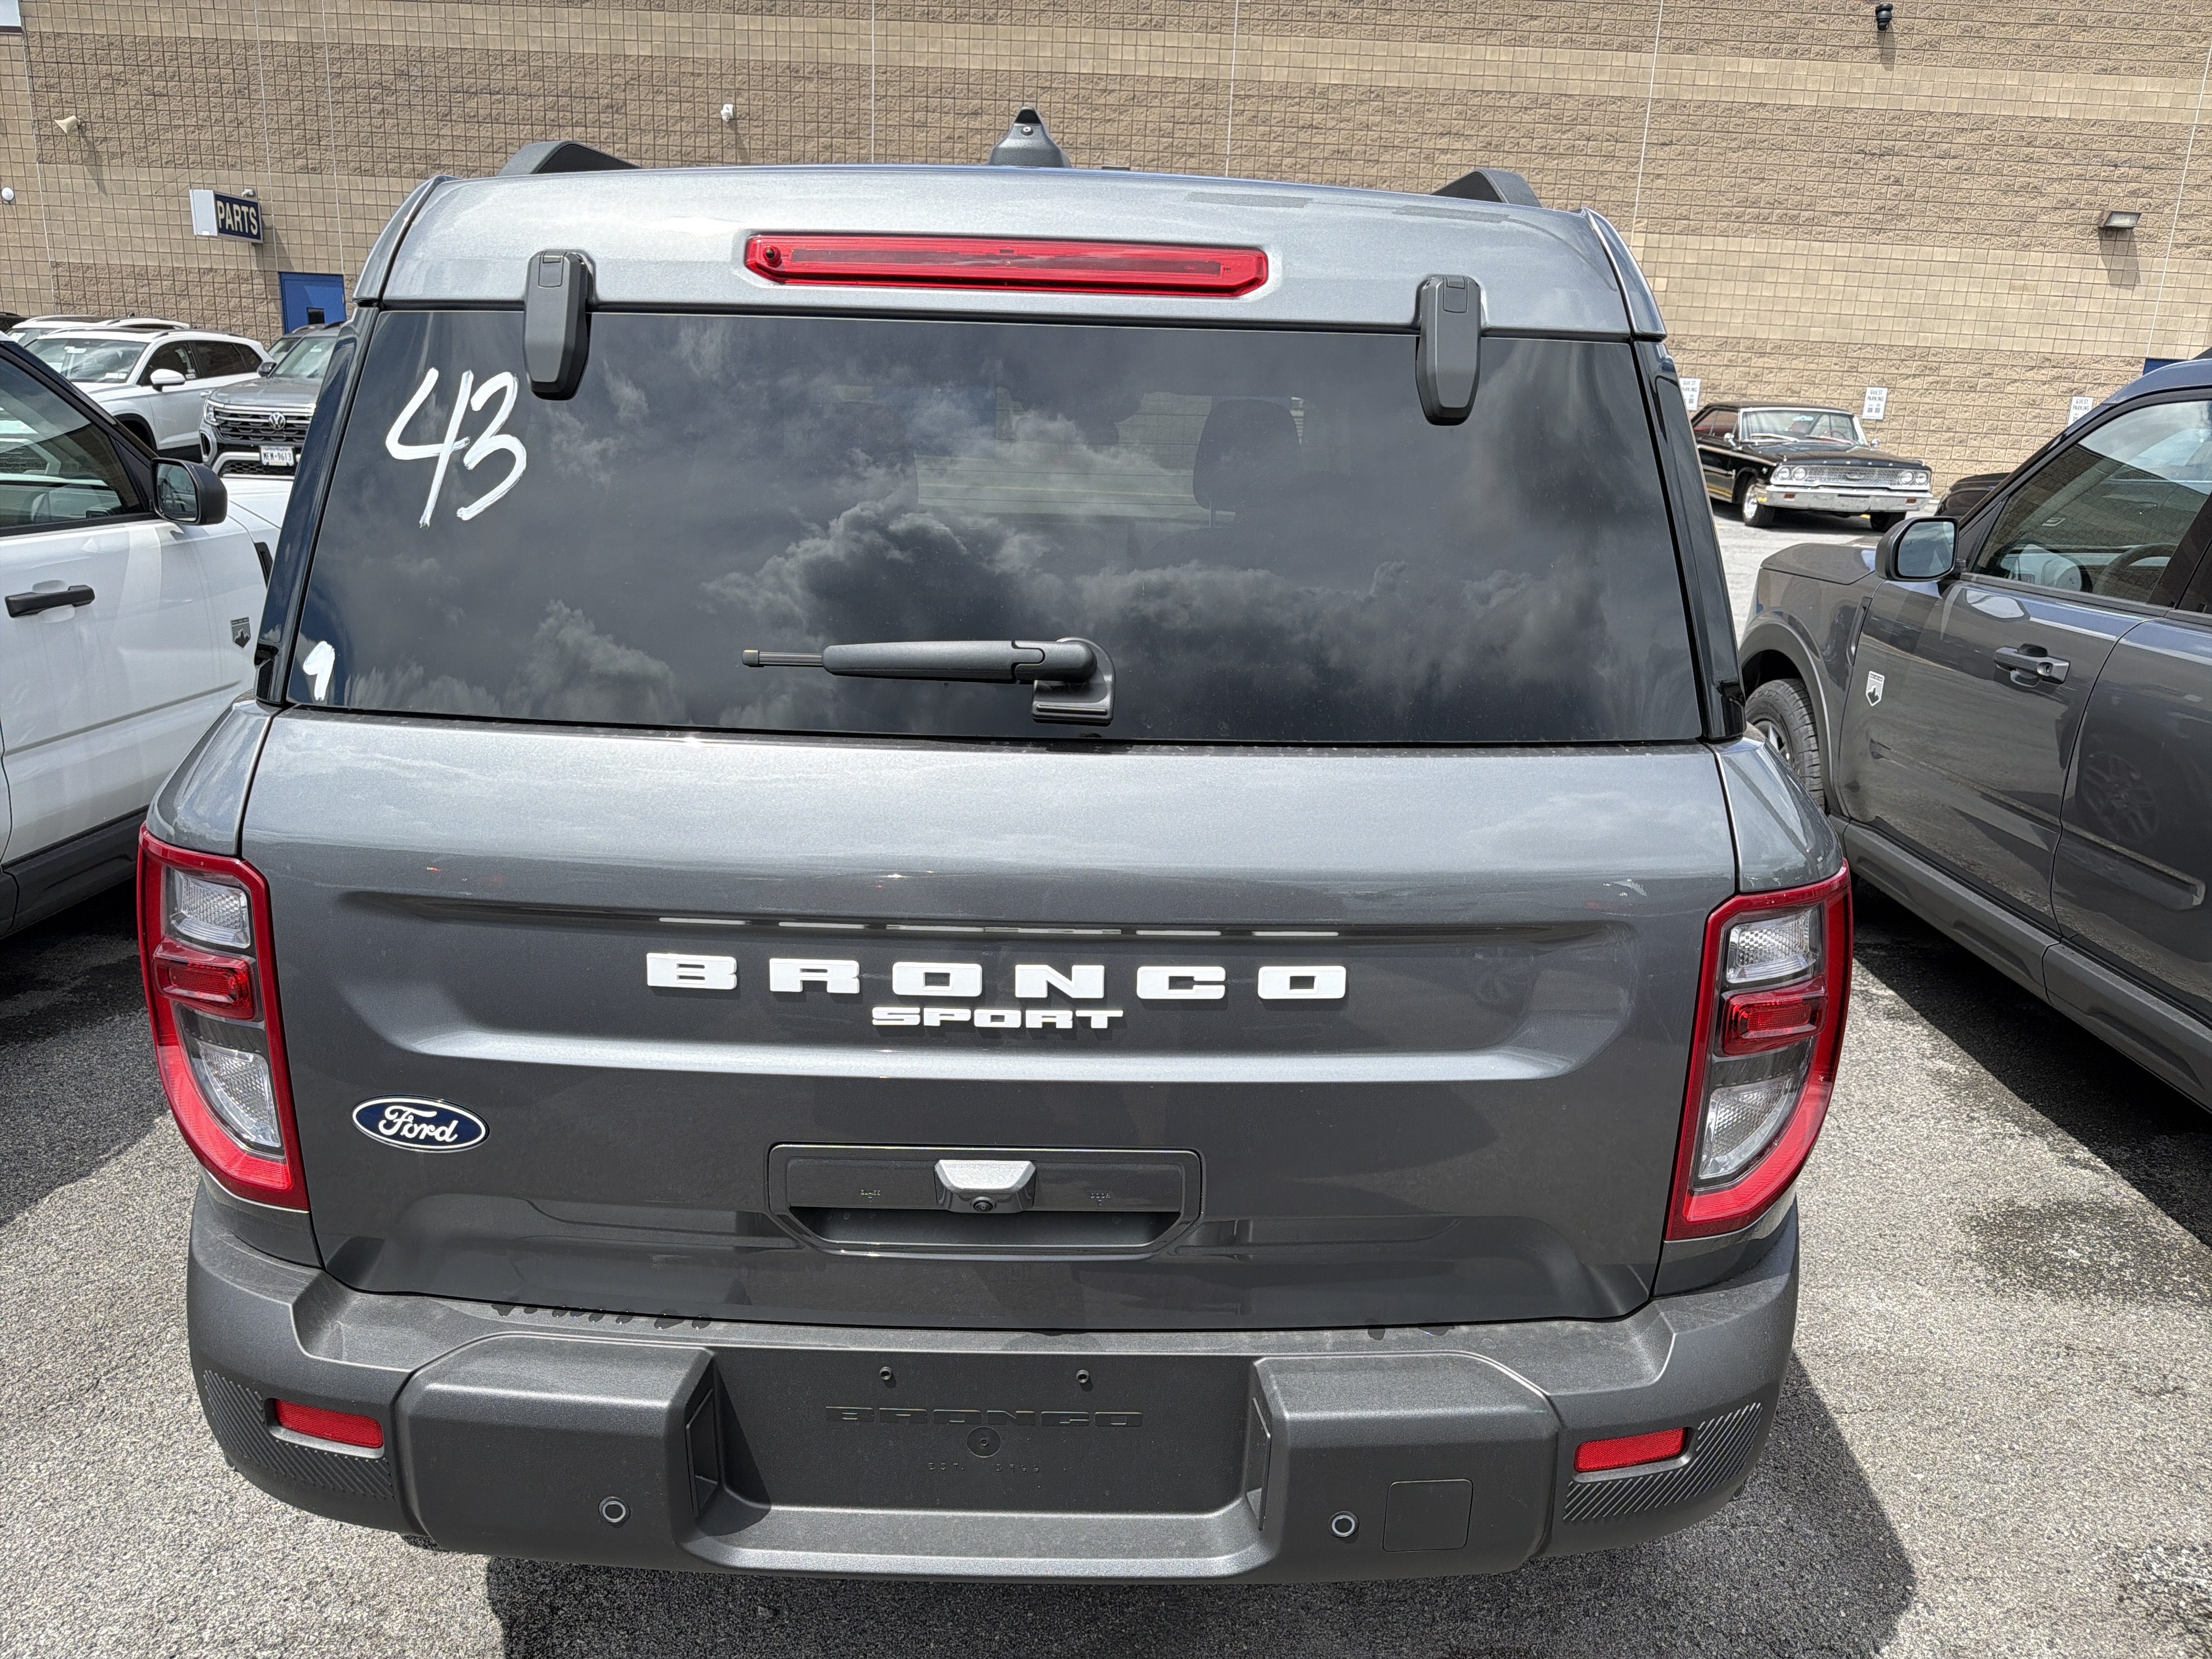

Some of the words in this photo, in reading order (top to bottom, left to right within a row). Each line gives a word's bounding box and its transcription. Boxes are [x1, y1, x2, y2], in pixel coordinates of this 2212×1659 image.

[217, 200, 258, 235] PARTS
[386, 367, 527, 528] 43
[647, 952, 1347, 1000] BRONCO
[872, 1006, 1124, 1029] SPORT
[379, 1105, 459, 1142] Ford
[825, 1406, 1143, 1426] BRONCO
